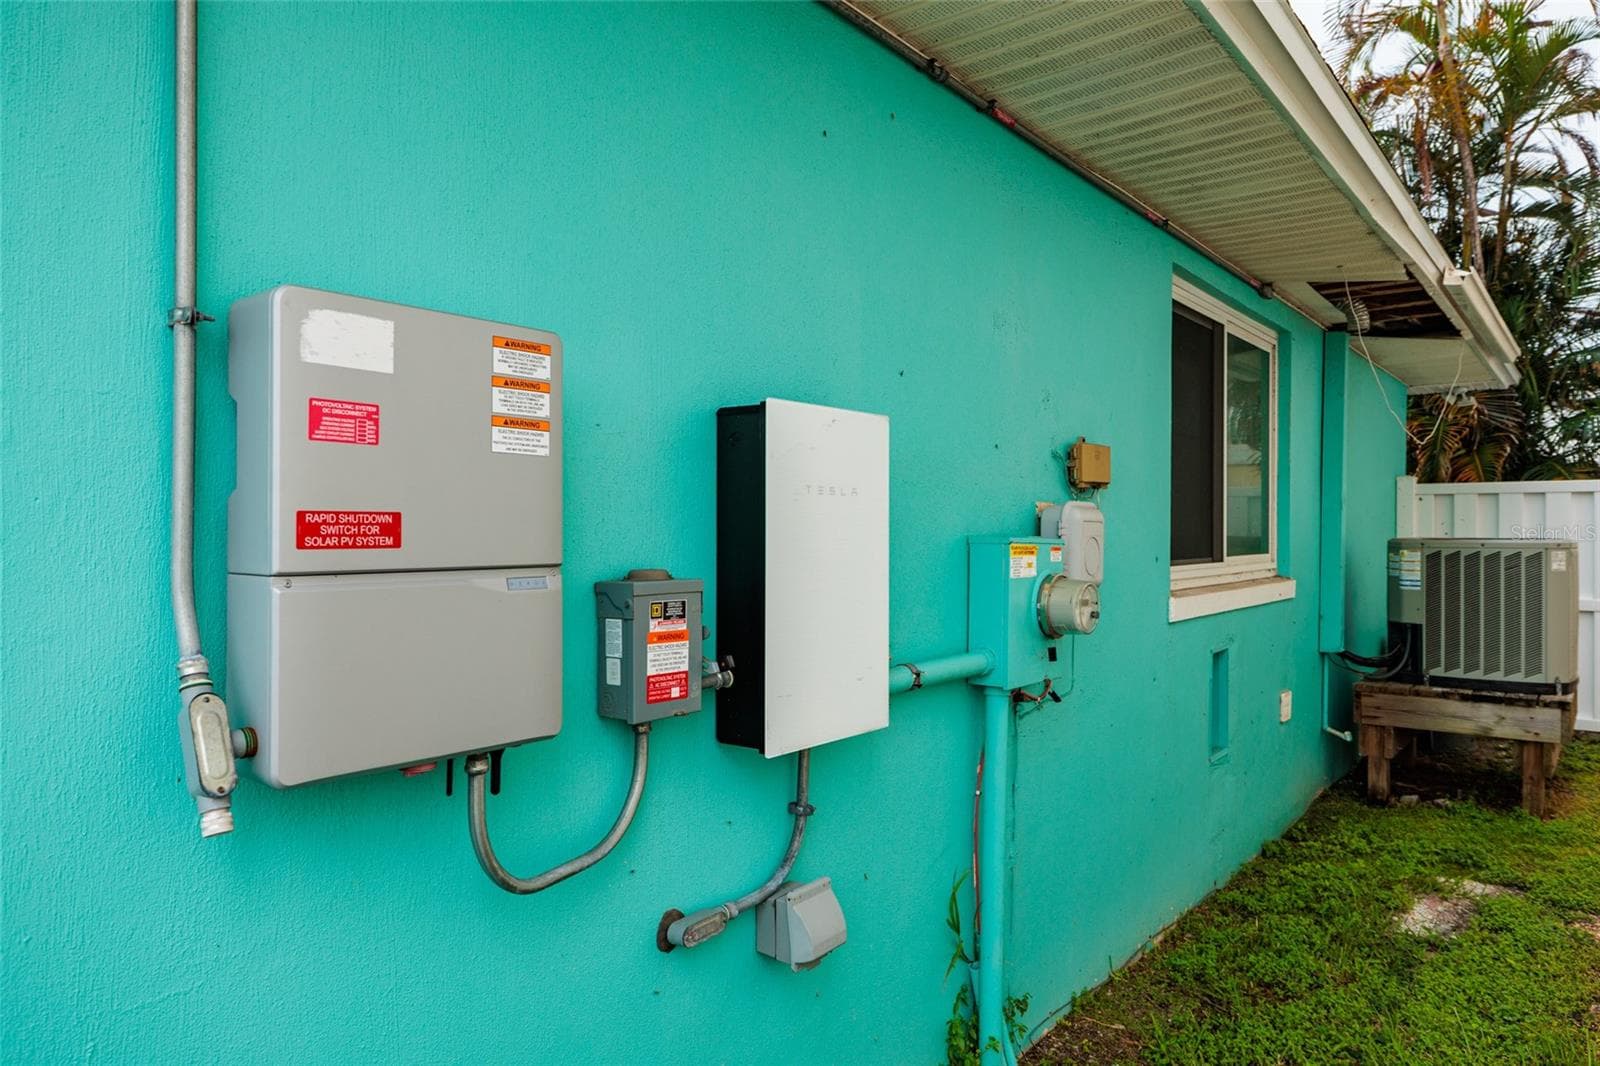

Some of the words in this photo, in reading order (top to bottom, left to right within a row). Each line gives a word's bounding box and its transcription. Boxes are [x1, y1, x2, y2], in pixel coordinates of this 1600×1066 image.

[510, 341, 542, 351] WARNING
[509, 380, 541, 390] WARNING
[509, 419, 541, 429] WARNING
[806, 484, 859, 497] TESLA
[305, 513, 337, 524] RAPID
[338, 513, 393, 524] SHUTDOWN
[320, 525, 358, 535] SWITCH
[360, 525, 380, 534] FOR
[304, 536, 339, 547] SOLAR
[340, 536, 354, 546] PV
[355, 536, 394, 546] SYSTEM
[657, 632, 685, 641] WARNING
